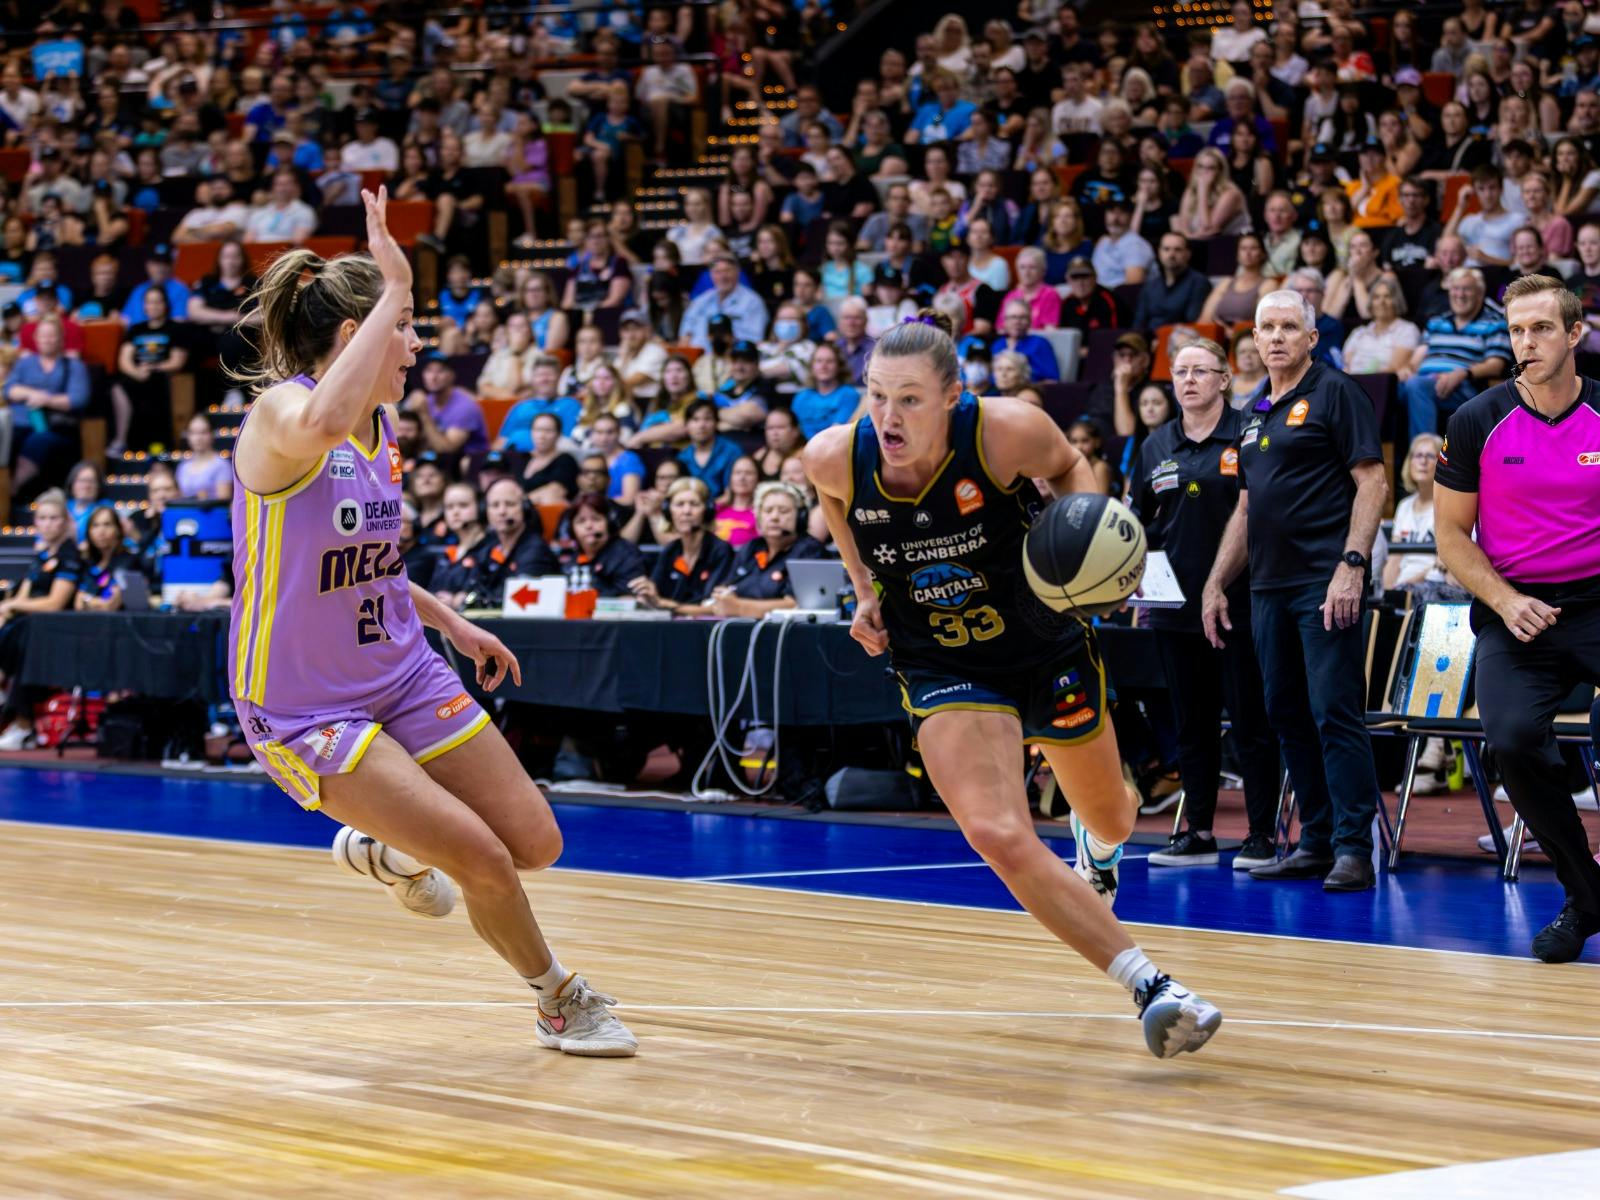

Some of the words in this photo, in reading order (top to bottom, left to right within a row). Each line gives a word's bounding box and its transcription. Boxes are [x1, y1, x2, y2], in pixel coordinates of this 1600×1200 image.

[901, 531, 967, 551] UNIVERSITY
[969, 523, 983, 537] OF
[905, 535, 988, 562] CANBERRA
[914, 577, 983, 603] CAPITALS
[357, 594, 392, 646] 21
[929, 604, 1005, 647] 33
